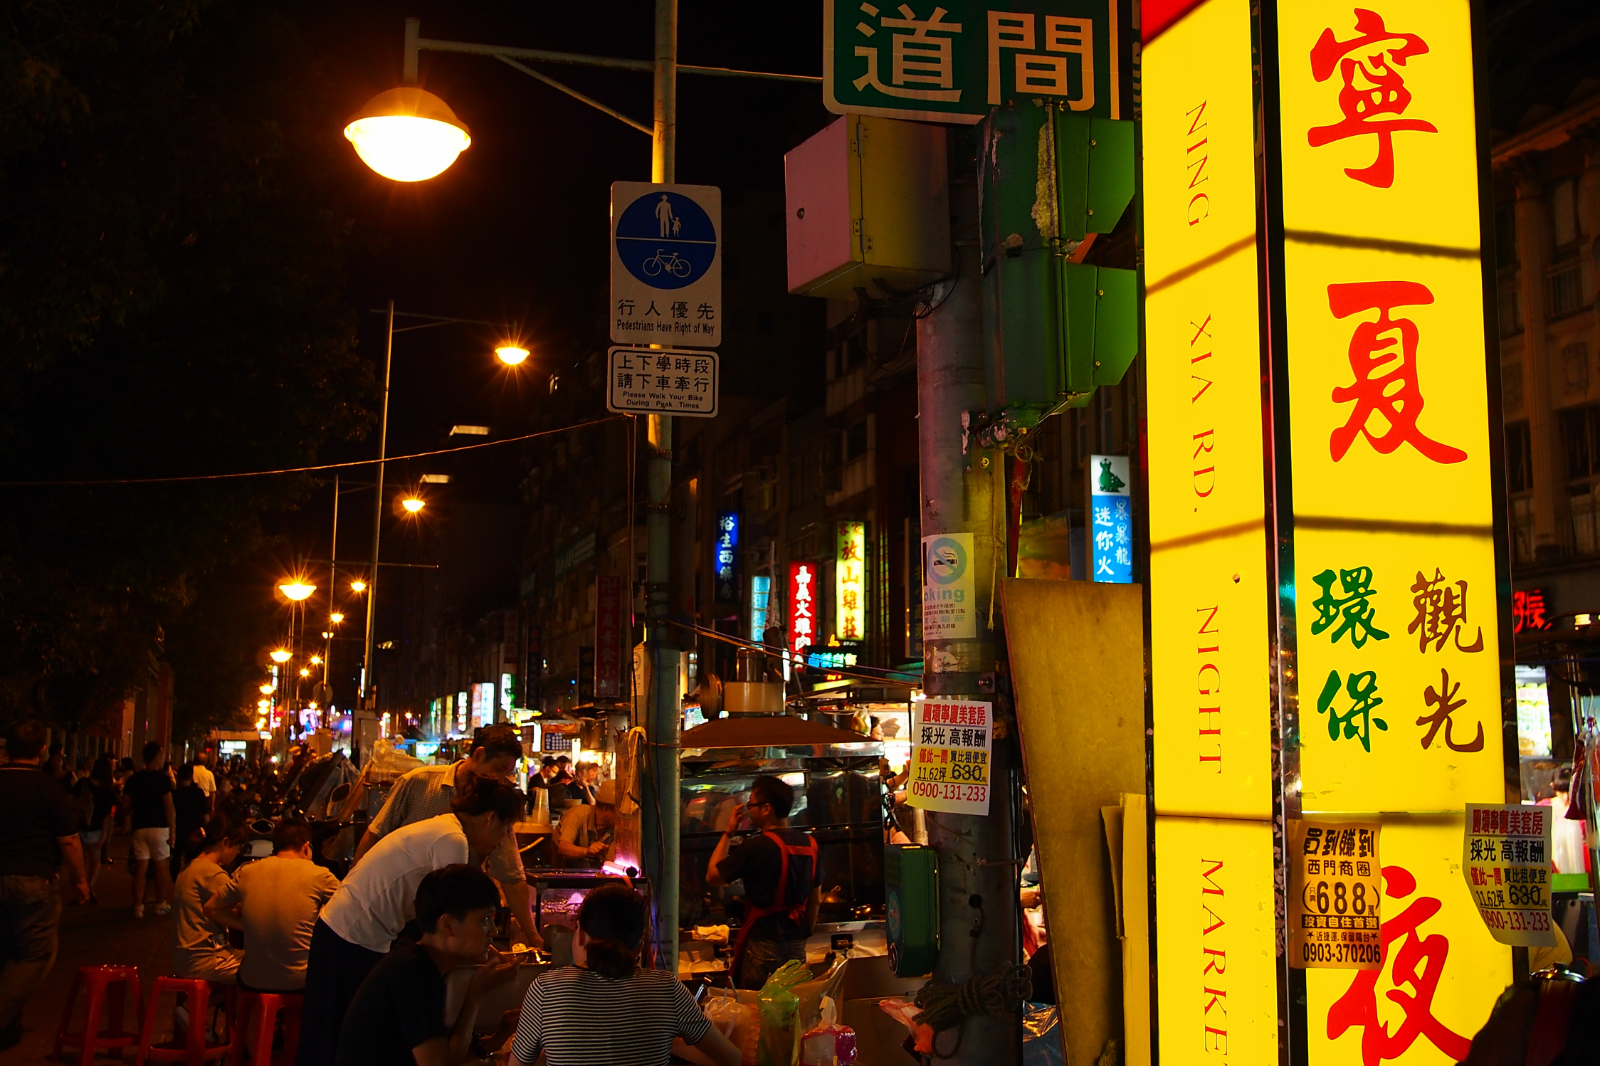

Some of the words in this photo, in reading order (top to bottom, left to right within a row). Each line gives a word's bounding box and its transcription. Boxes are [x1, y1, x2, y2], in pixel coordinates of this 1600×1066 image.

[852, 2, 1095, 111] 道間
[1185, 100, 1209, 227] NING
[1308, 8, 1468, 464] 寧夏
[618, 299, 714, 320] 行人優先
[617, 319, 654, 331] Pedestrians
[657, 321, 672, 332] Have
[675, 322, 691, 336] Right
[694, 323, 700, 333] of
[702, 323, 714, 336] Way
[618, 355, 710, 374] 上下學時段
[1190, 313, 1213, 404] XIA
[617, 373, 710, 392] 請下車牽行
[622, 391, 646, 399] Please
[626, 399, 649, 407] During
[656, 400, 673, 408] Peak
[1192, 428, 1215, 513] RD.
[1094, 506, 1115, 583] 迷你火
[1311, 566, 1389, 753] 環保
[1408, 567, 1484, 753] 觀光
[1196, 605, 1222, 774] NIGHT
[921, 726, 945, 745] 採光
[949, 728, 986, 747] 高報酬
[919, 748, 948, 764] 僅此一間
[950, 751, 987, 764] 買比租便宜
[917, 767, 946, 782] 11.62坪
[912, 781, 986, 802] 0900-131-233
[1303, 827, 1374, 857] 買到賺到
[1470, 838, 1496, 861] 採光
[1500, 839, 1545, 863] 高報酬
[1308, 859, 1370, 876] 西門商圈
[1470, 866, 1502, 886] 僅此一間
[1504, 868, 1547, 884] 買比租便宜
[1476, 890, 1505, 908] 11.62坪
[1304, 916, 1378, 929] 投資自住首選
[1481, 909, 1550, 931] 0900-131-233
[1201, 858, 1228, 1066] MARKE
[1303, 942, 1381, 964] 0903-370206
